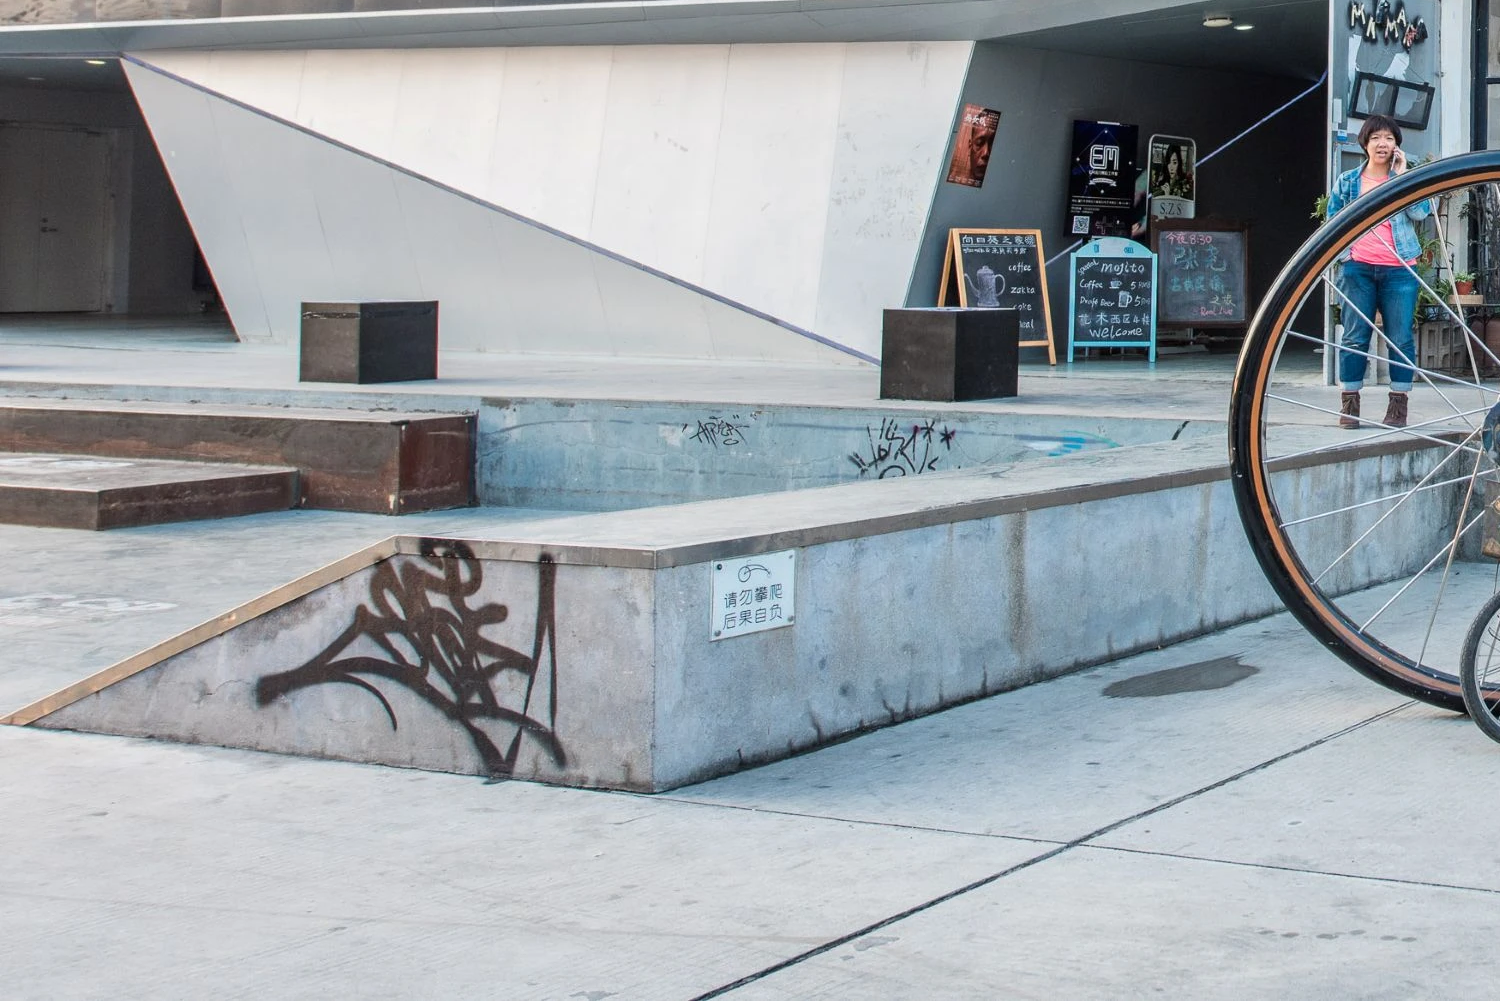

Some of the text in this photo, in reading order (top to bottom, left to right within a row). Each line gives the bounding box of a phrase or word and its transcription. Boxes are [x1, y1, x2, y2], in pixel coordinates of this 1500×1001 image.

[1008, 262, 1032, 273] coffee
[1130, 281, 1137, 290] 5
[1134, 296, 1141, 307] 5
[724, 583, 783, 609] 请勿攀爬
[722, 603, 783, 630] 后果自负
